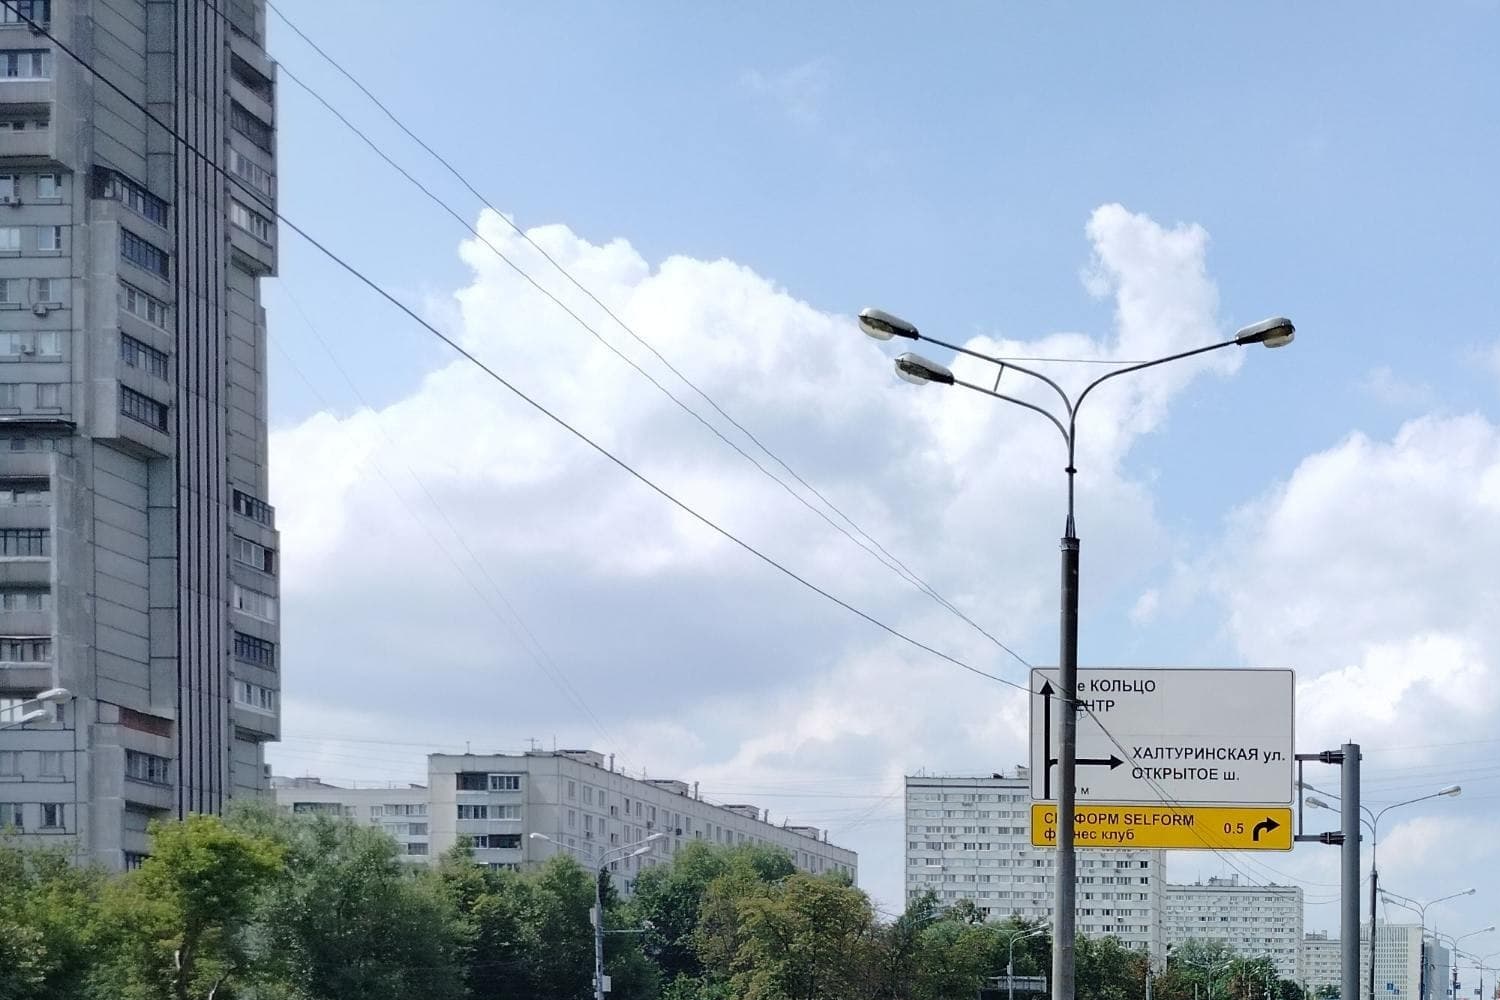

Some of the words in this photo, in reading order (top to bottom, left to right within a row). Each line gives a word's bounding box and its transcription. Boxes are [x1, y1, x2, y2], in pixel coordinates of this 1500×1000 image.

[1091, 680, 1156, 694] КОЛЬЦО
[1075, 700, 1115, 712] ЕНТР
[1132, 747, 1258, 760] ХАЛТУРИНСКАЯ
[1263, 751, 1285, 763] ул.
[1132, 767, 1218, 780] ОТКРЫТОЕ
[1223, 771, 1240, 780] ш.
[1044, 812, 1118, 825] СФОРМ
[1124, 813, 1194, 826] SELFORM
[1223, 823, 1244, 834] 0.5
[1044, 827, 1097, 841] фнес
[1102, 829, 1135, 842] клуб
